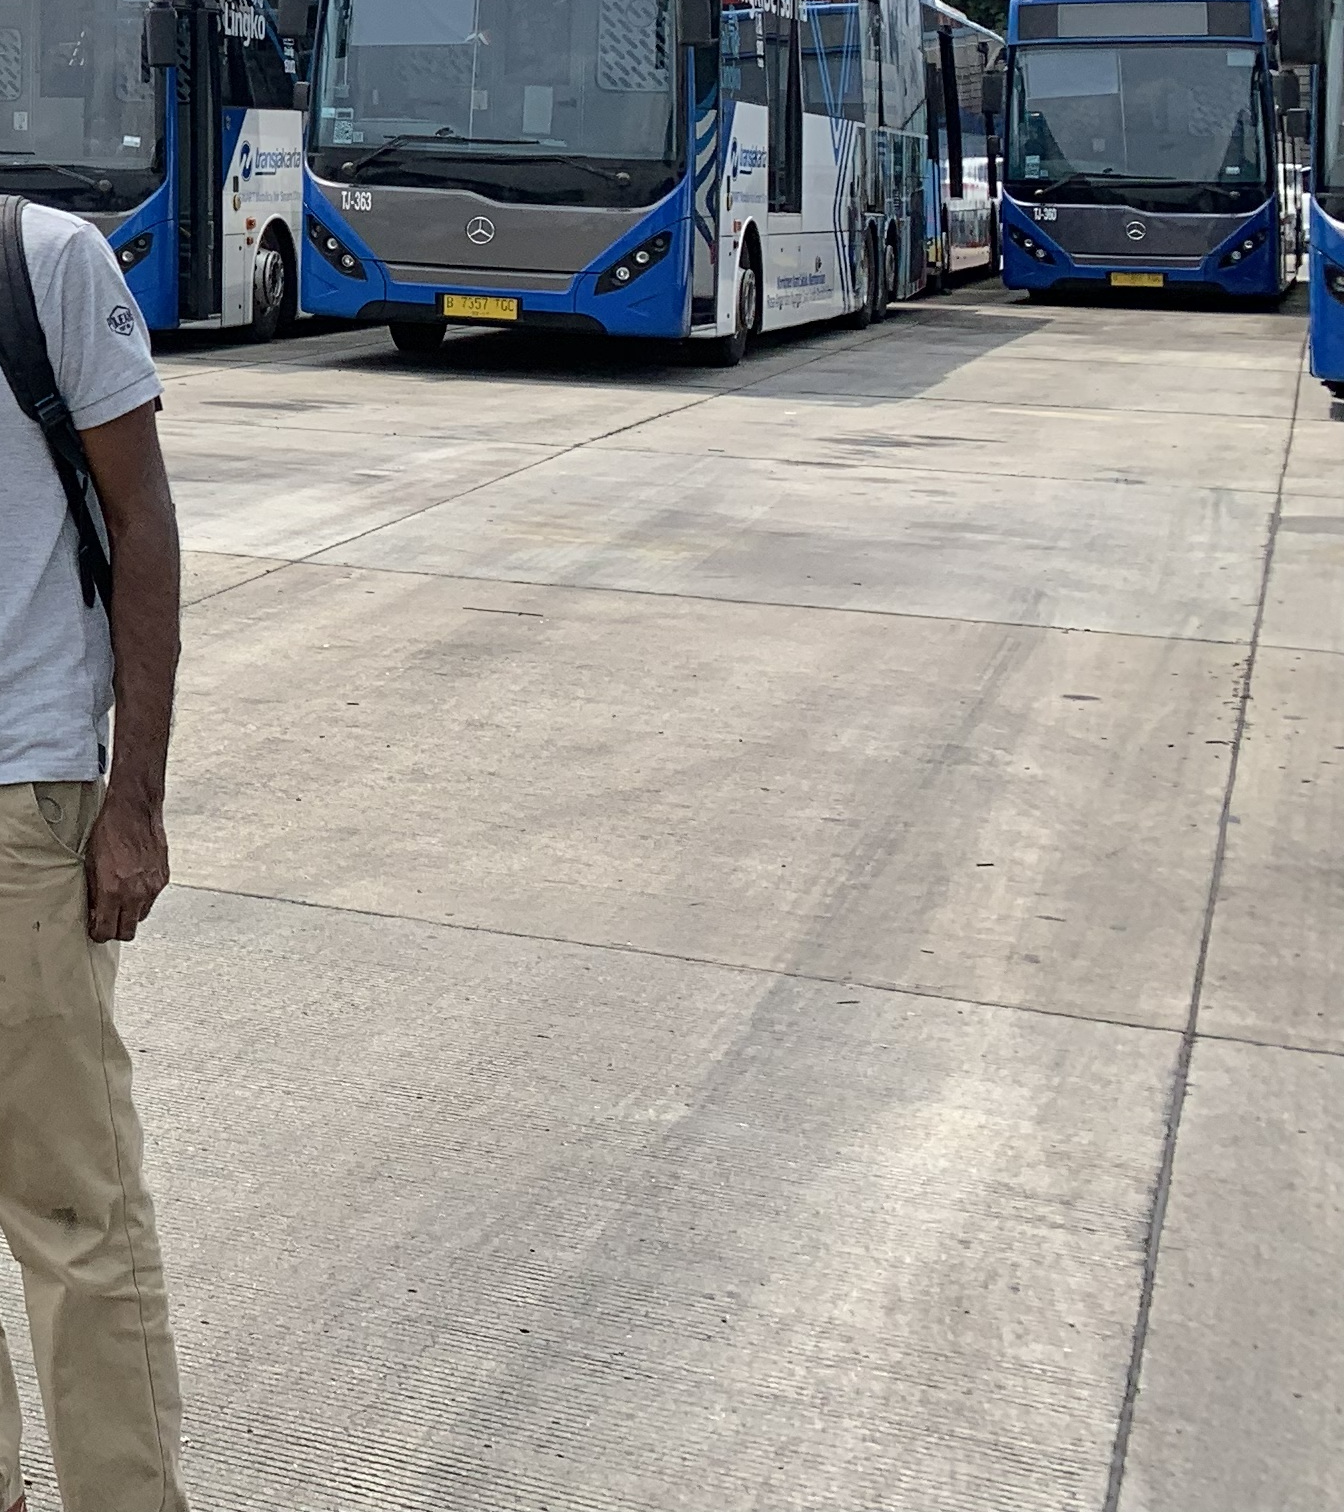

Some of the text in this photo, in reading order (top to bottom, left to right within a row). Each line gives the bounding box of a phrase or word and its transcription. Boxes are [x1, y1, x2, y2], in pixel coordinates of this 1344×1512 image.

[224, 1, 266, 47] Lingko
[255, 147, 301, 176] transjakarta
[341, 191, 372, 211] TJ-363
[446, 296, 454, 309] B
